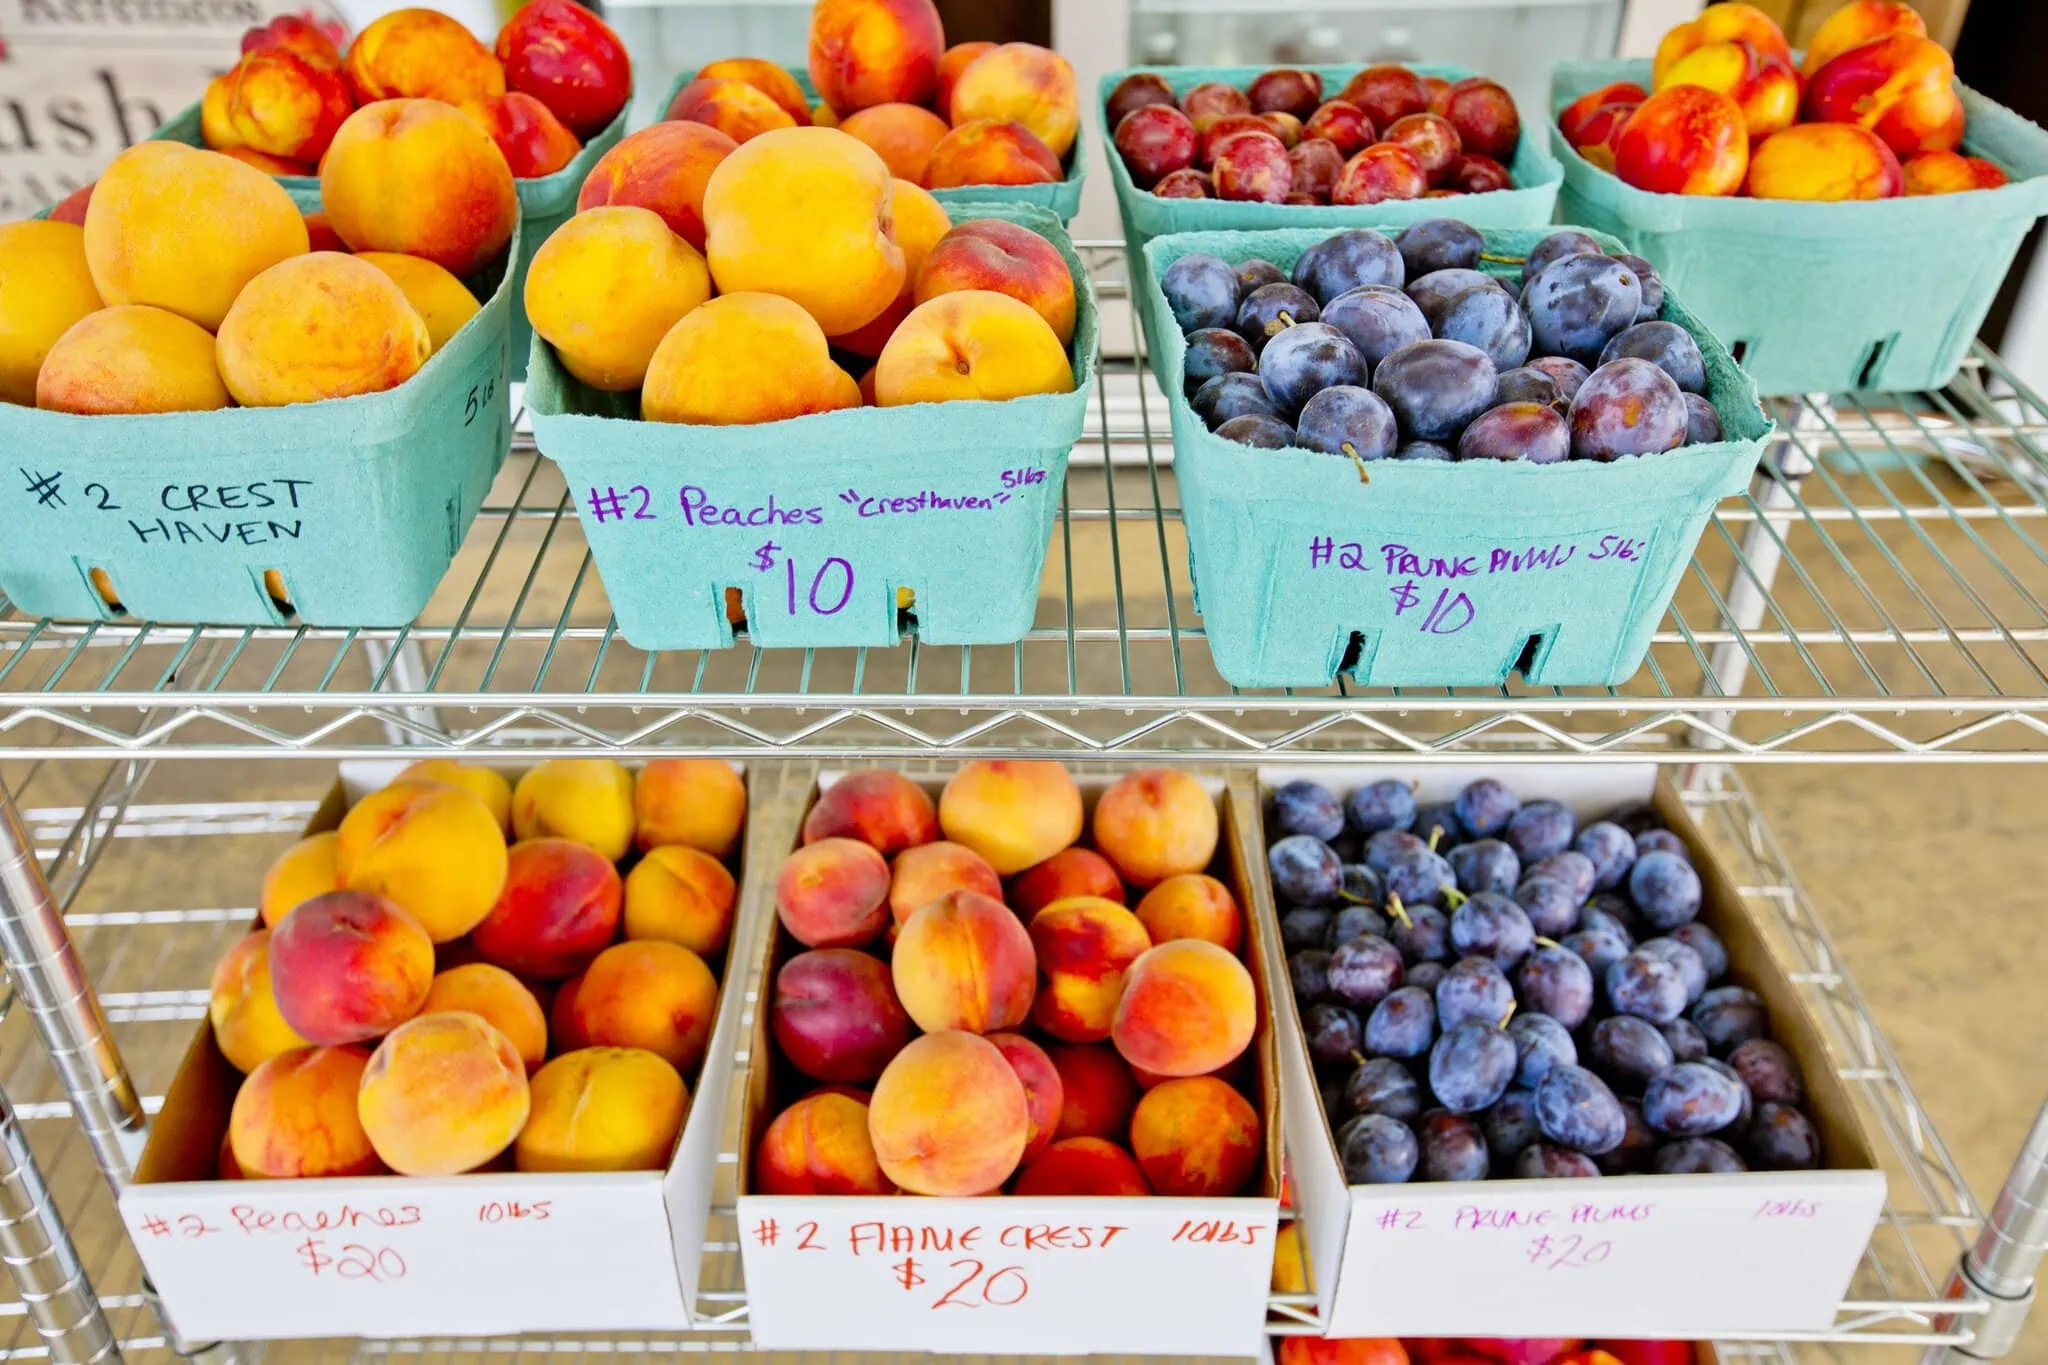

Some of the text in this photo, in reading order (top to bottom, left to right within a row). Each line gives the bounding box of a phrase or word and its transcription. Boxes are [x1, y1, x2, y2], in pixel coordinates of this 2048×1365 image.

[161, 479, 313, 511] CREST
[587, 485, 656, 524] #2
[680, 485, 823, 526] Peaches
[128, 519, 302, 545] HAVEN
[1309, 536, 1372, 571] #2
[749, 540, 854, 616] $10
[1390, 579, 1475, 634] $10
[230, 1203, 421, 1235] Peaches
[1453, 1205, 1556, 1231] PRUNE
[1000, 1223, 1129, 1250] CREST
[1526, 1233, 1612, 1271] $20
[296, 1236, 407, 1282] $20
[890, 1256, 1029, 1310] $20
